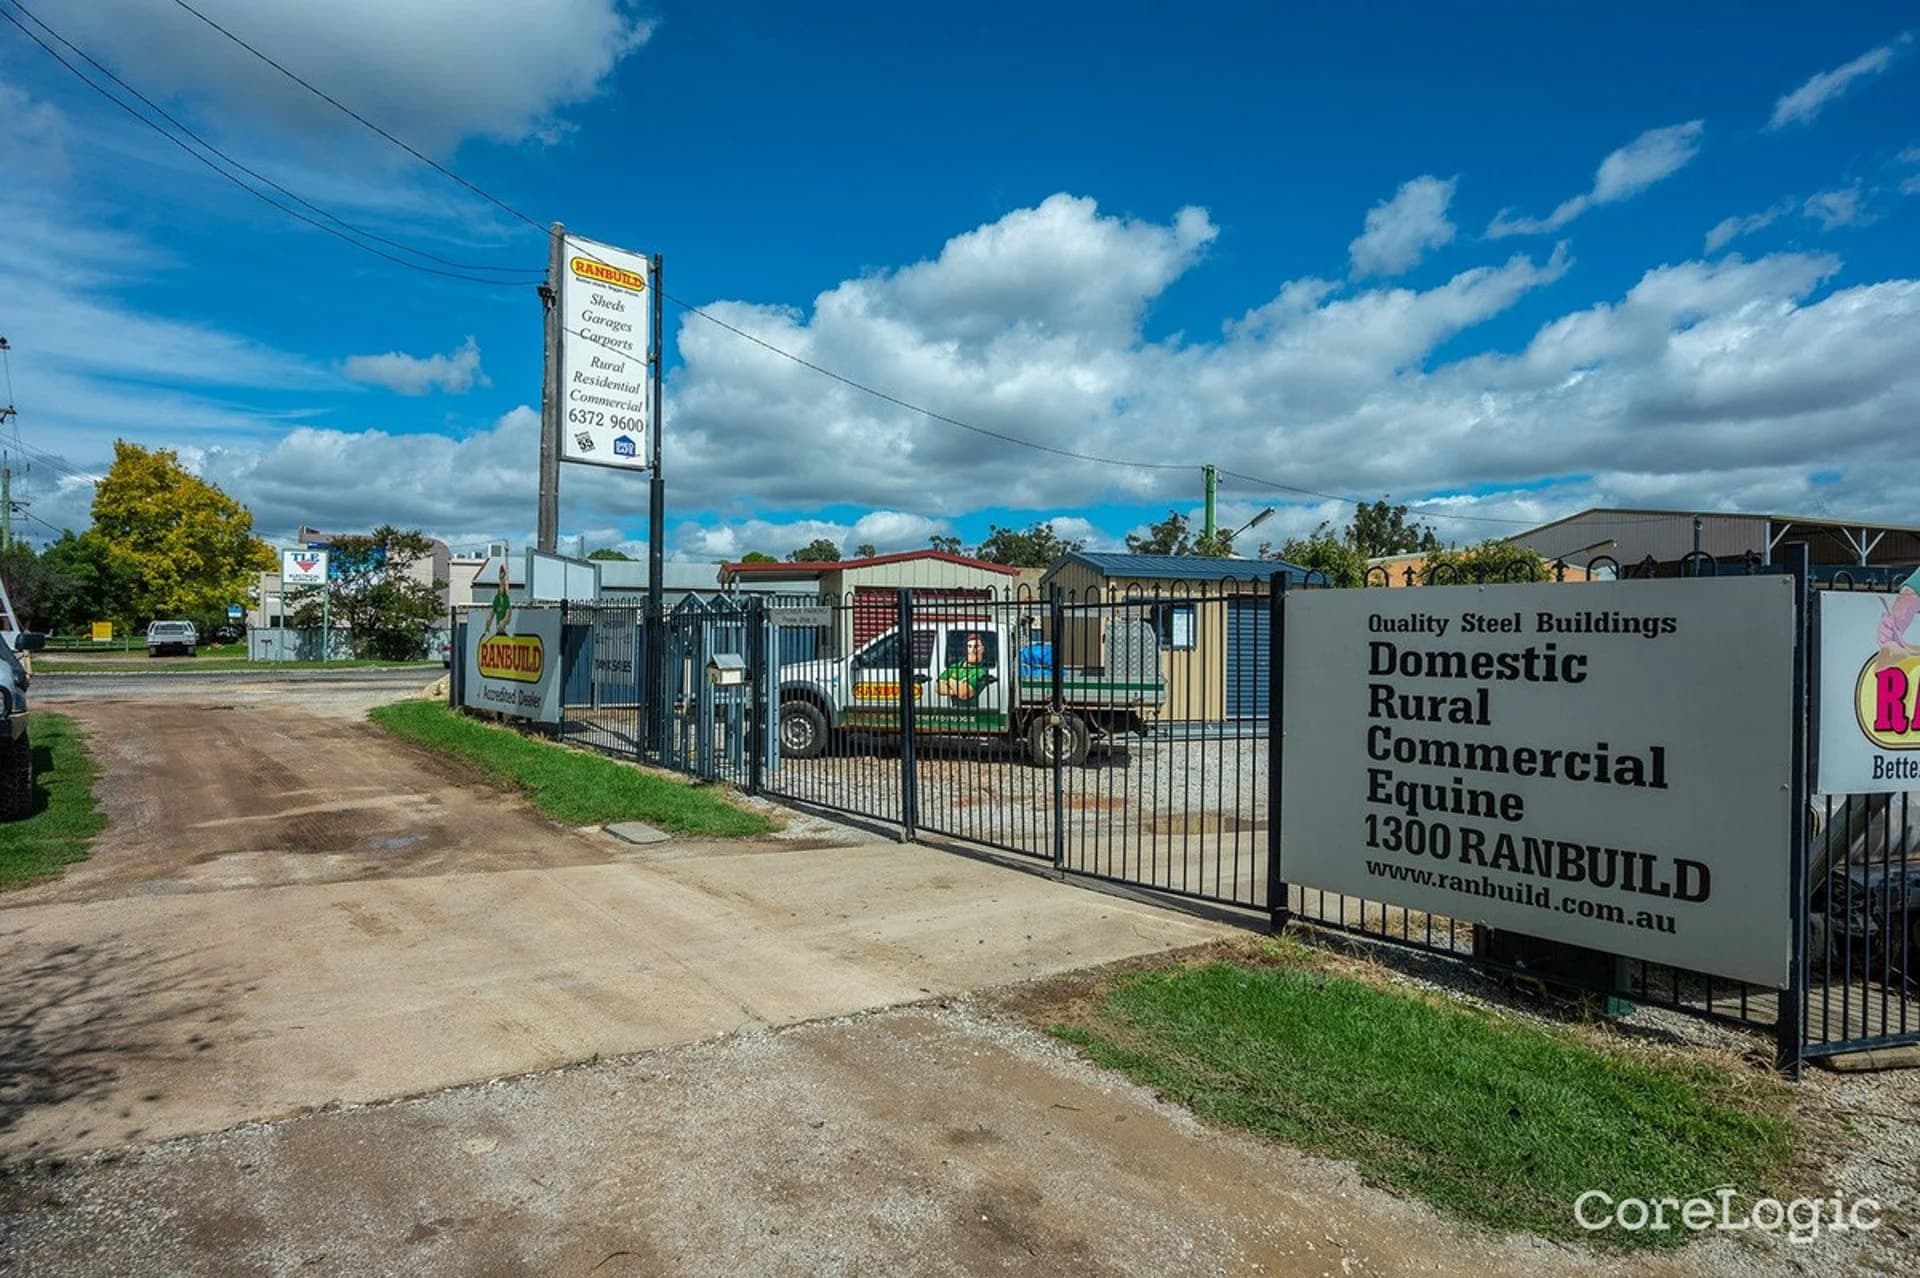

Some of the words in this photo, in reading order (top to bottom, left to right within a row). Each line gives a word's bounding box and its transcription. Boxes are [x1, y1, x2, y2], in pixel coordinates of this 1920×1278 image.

[575, 260, 643, 288] RANBUILD
[590, 293, 625, 313] Sheds
[581, 309, 633, 333] Garages
[580, 327, 633, 351] Carports
[590, 355, 625, 374] Rural
[573, 370, 640, 395] Residential
[569, 389, 642, 413] Commercial
[569, 408, 604, 426] 6372
[610, 414, 644, 432] 9600
[291, 553, 319, 561] TLE
[1368, 613, 1449, 637] Quality
[1460, 612, 1522, 633] Steel
[1536, 612, 1677, 639] Buildings
[481, 643, 541, 673] RANBUILD
[1368, 641, 1588, 684] Domestic
[1367, 683, 1491, 726] Rural
[1367, 725, 1668, 790] Commercial
[1872, 754, 1920, 780] Bette
[1367, 768, 1524, 822] Equine
[1365, 814, 1452, 860] 1300
[1458, 827, 1711, 904] RANBUILD
[1366, 860, 1677, 935] www.ranbuild.com.au
